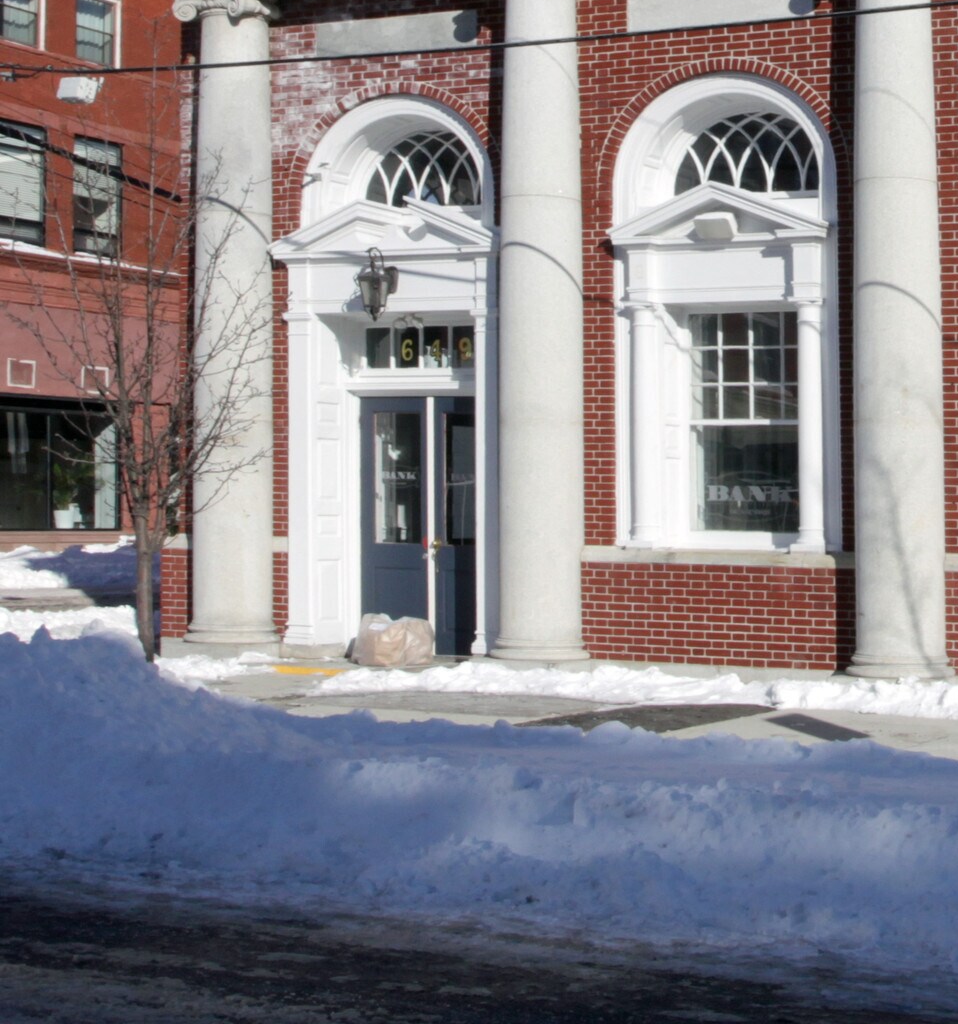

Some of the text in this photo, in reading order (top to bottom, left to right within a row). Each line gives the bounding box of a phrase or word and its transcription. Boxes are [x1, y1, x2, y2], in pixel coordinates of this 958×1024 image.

[401, 337, 472, 361] 649
[382, 471, 417, 480] BANK
[706, 485, 792, 502] BANK
